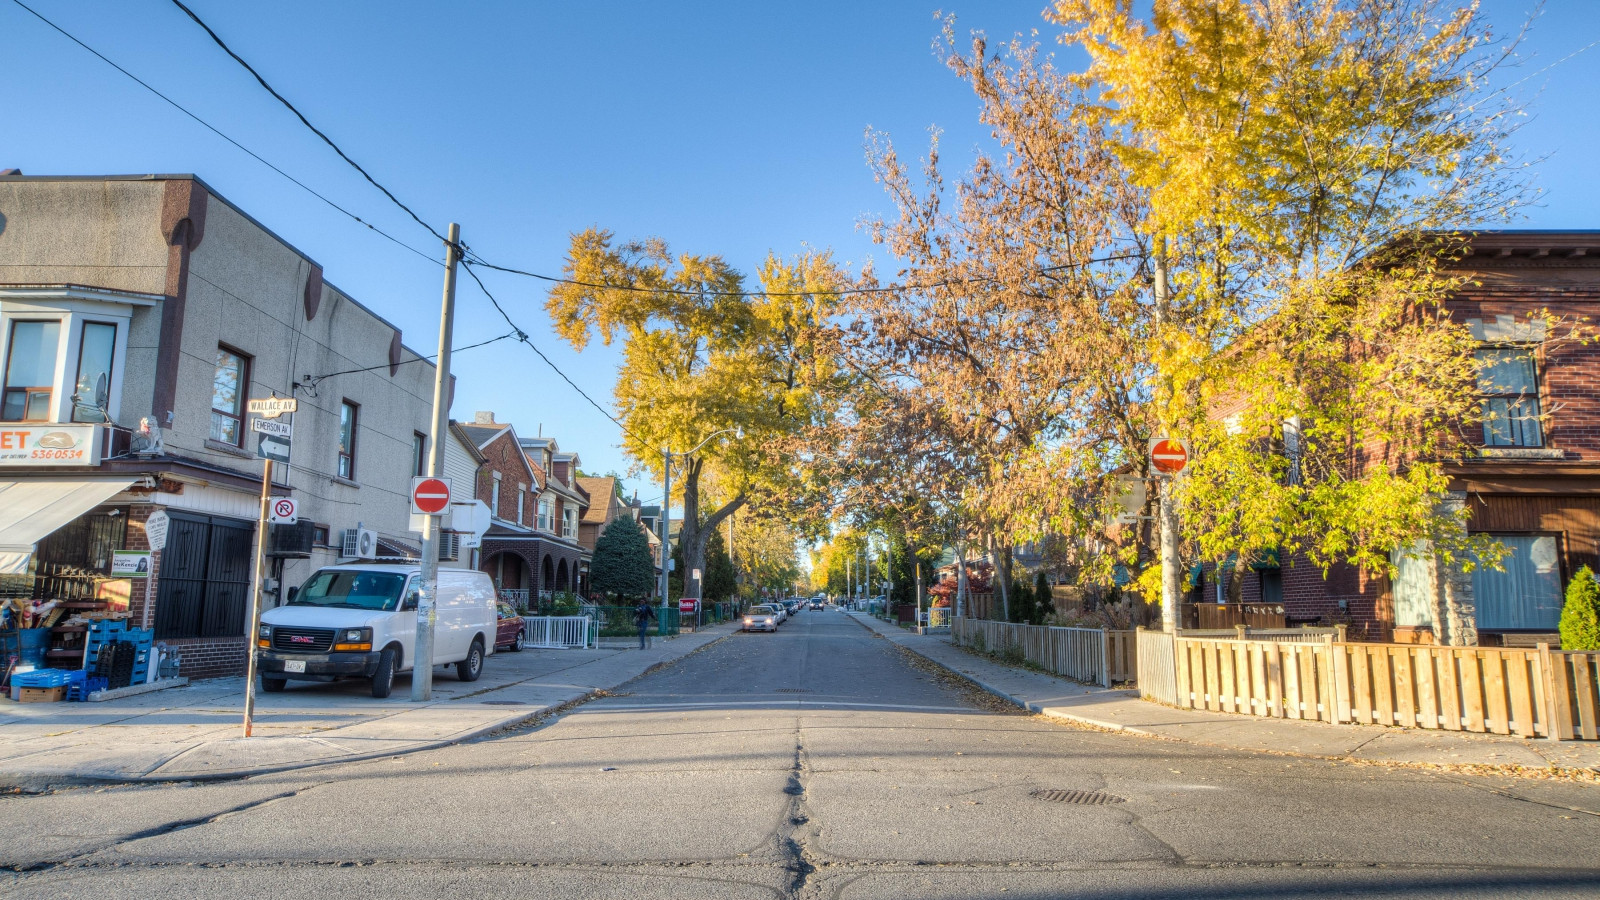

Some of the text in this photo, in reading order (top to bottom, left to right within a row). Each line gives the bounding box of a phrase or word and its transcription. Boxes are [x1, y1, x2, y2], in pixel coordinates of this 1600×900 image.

[251, 401, 281, 410] WALLACE
[256, 420, 281, 432] EMERSON
[291, 635, 314, 643] GMC
